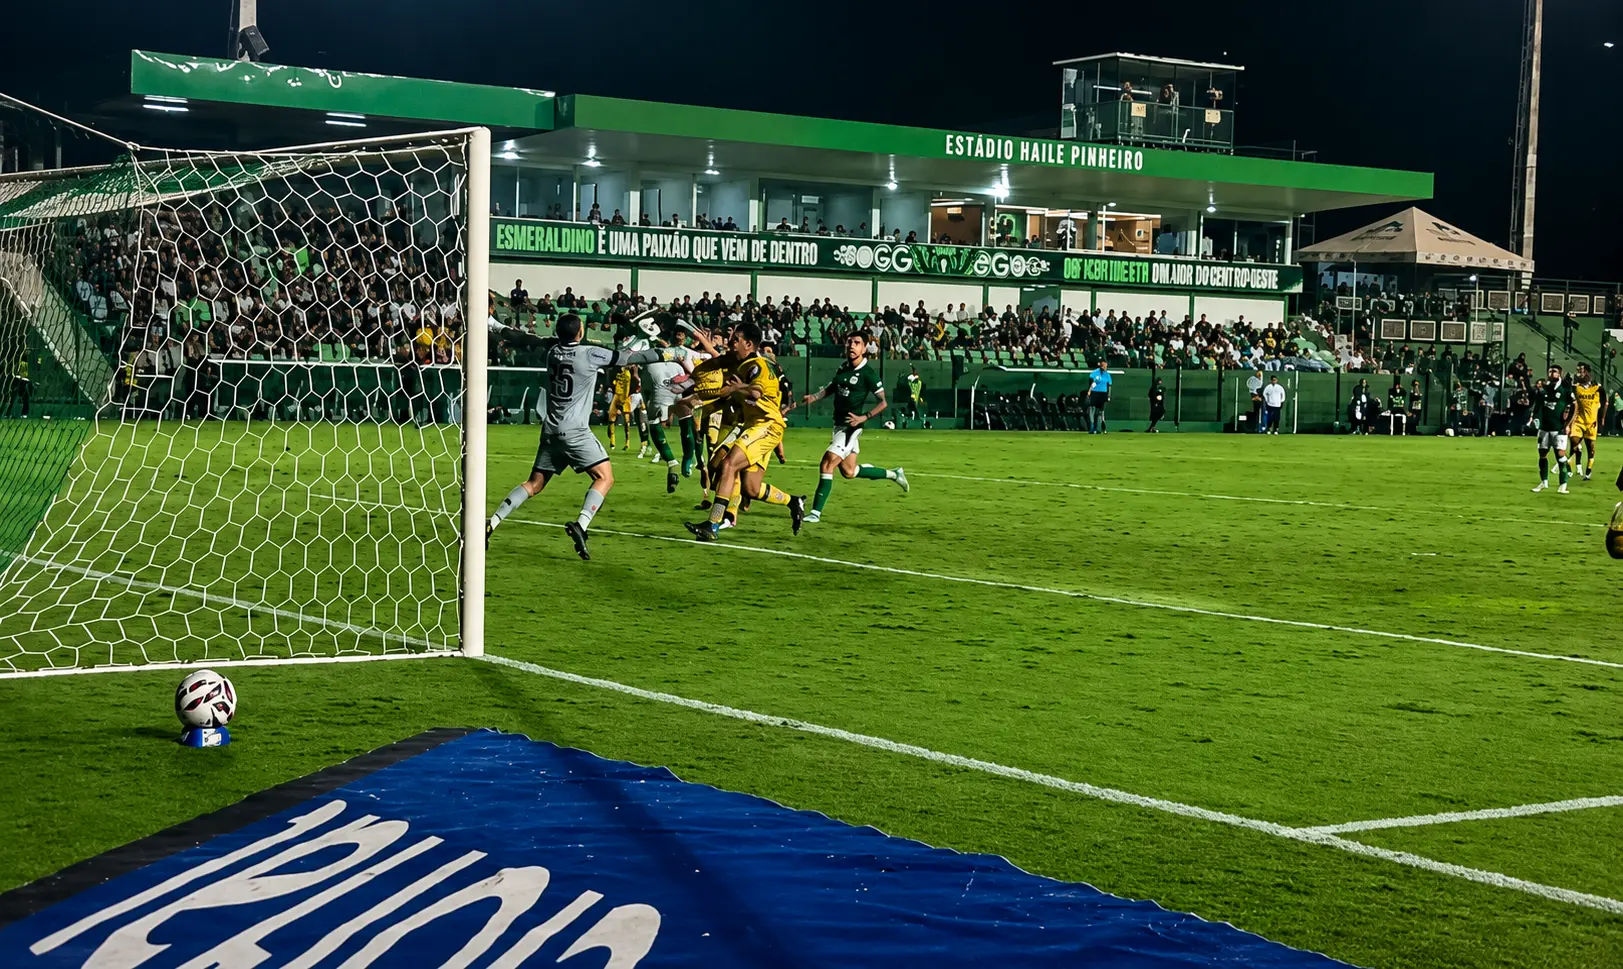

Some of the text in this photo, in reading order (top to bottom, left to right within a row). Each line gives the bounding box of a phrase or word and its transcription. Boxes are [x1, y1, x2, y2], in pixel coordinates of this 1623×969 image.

[945, 133, 1143, 171] ESTÁDIO HAILE PINHEIRO
[496, 224, 595, 254] ESMERALDINO
[609, 230, 640, 256] UMA
[642, 231, 689, 259] PAIXÃO
[692, 235, 718, 262] QUE
[751, 239, 767, 263] DE
[769, 240, 818, 265] DENTRO
